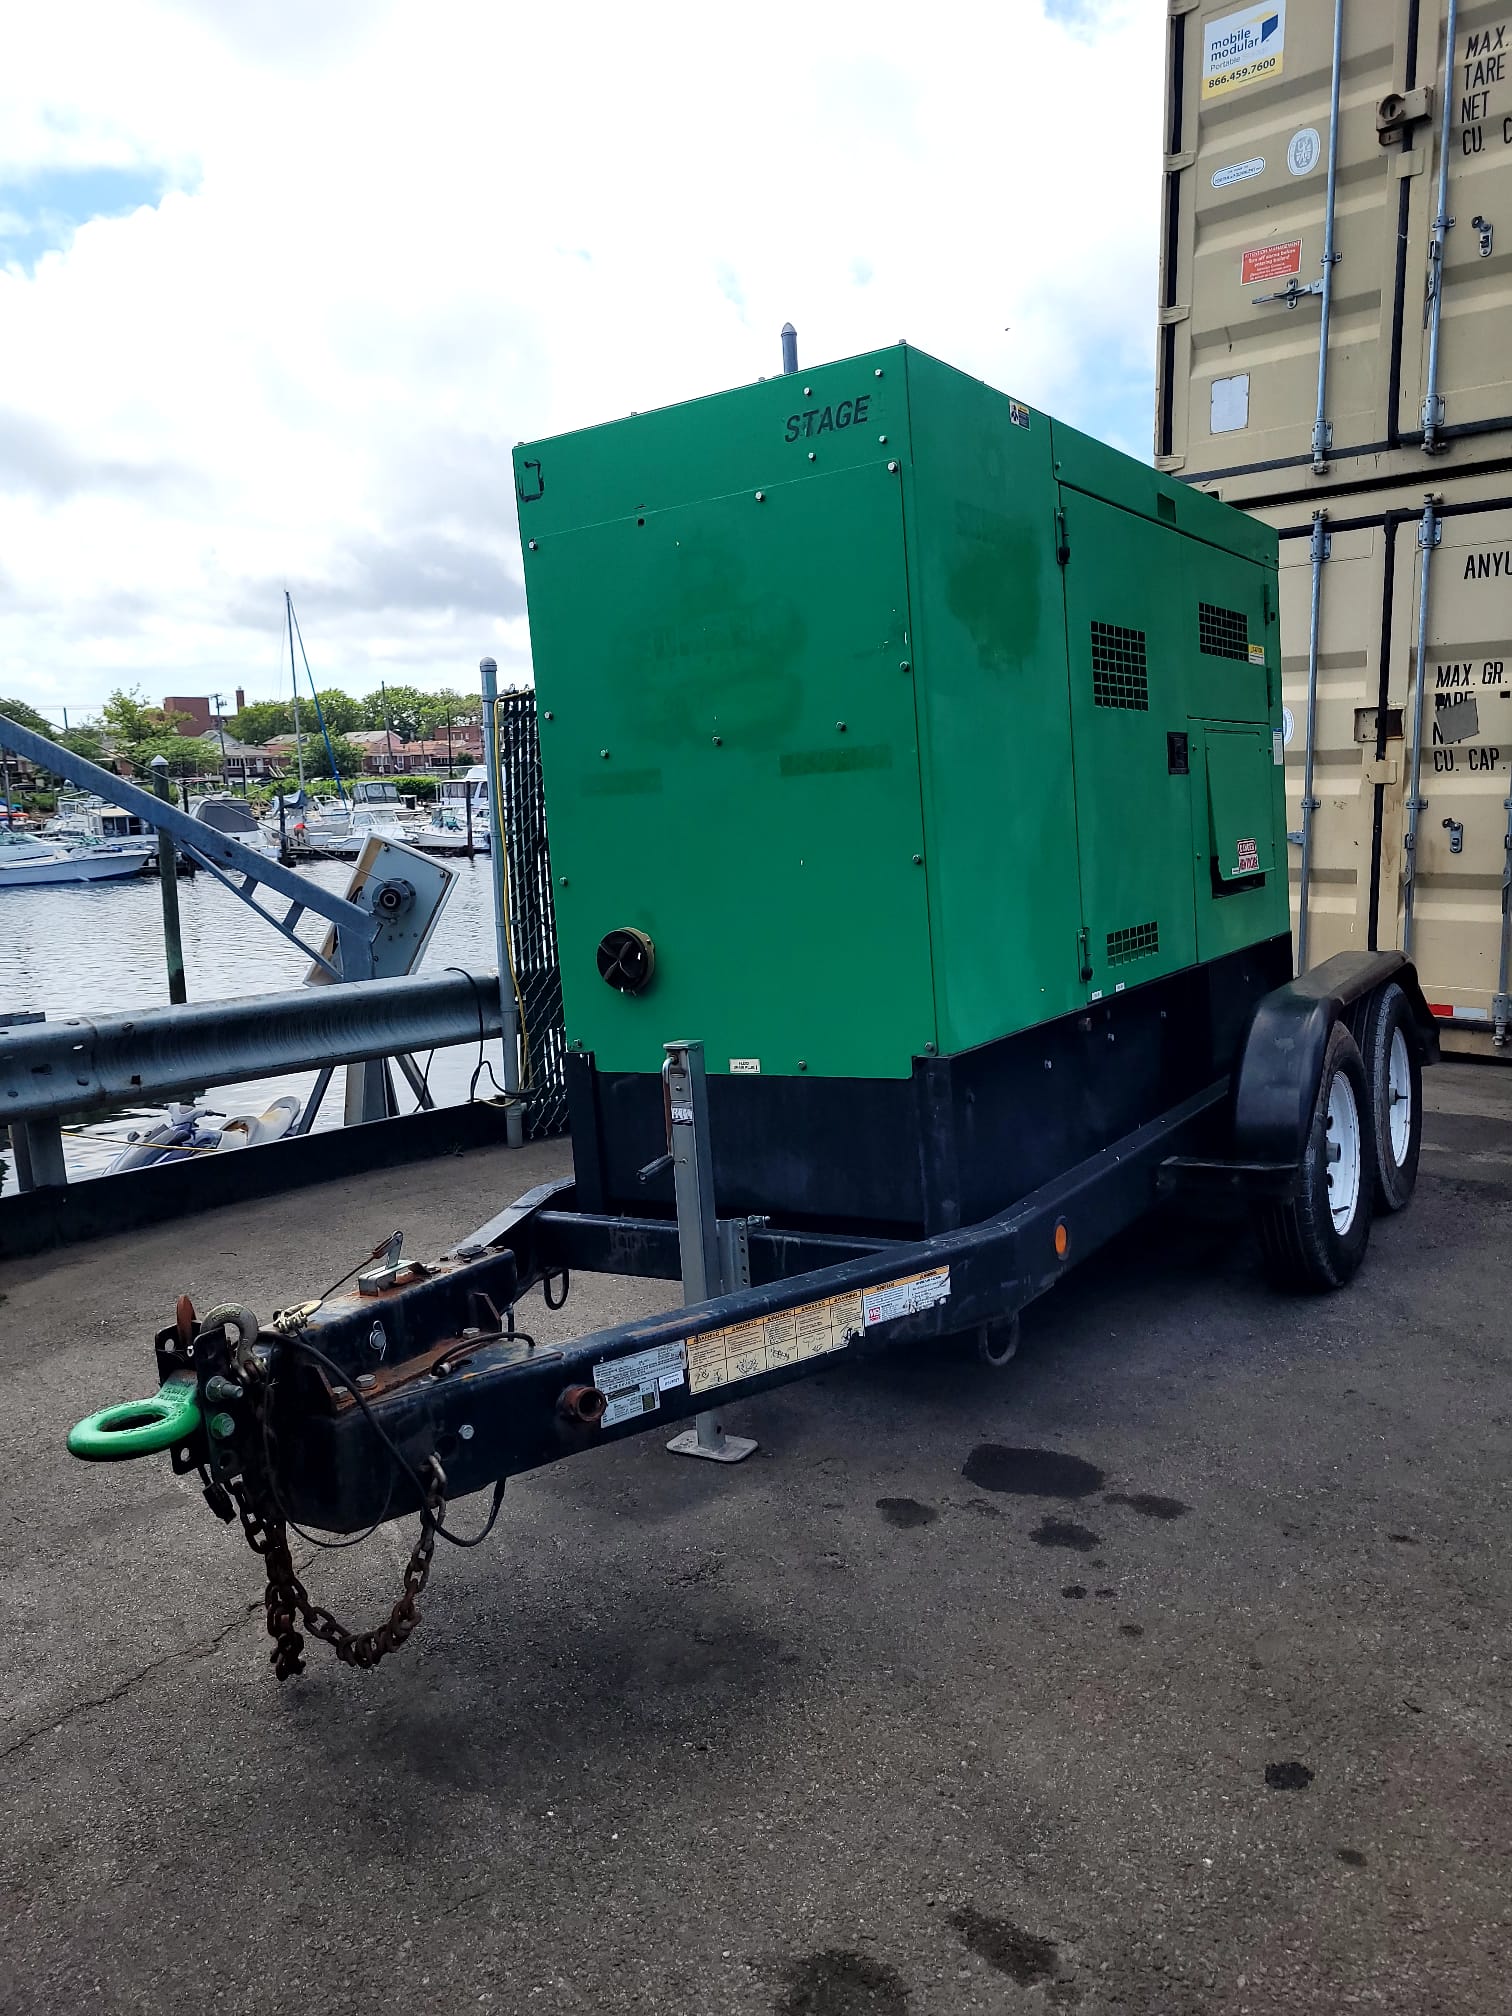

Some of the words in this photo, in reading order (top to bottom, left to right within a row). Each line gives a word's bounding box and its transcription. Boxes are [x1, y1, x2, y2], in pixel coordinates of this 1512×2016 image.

[1210, 37, 1259, 62] modular
[1211, 28, 1251, 51] mobile
[1465, 25, 1509, 59] MAX.
[1208, 57, 1276, 88] 866.459.7600
[1210, 56, 1241, 72] Portable
[1463, 52, 1507, 91] TARE
[1461, 90, 1490, 123] NET
[1462, 125, 1486, 155] CU.
[784, 394, 871, 443] STAGE
[1436, 663, 1476, 688] MAX.
[1481, 661, 1508, 685] GR.
[1433, 749, 1460, 772] CU.
[1468, 747, 1506, 771] CAP.
